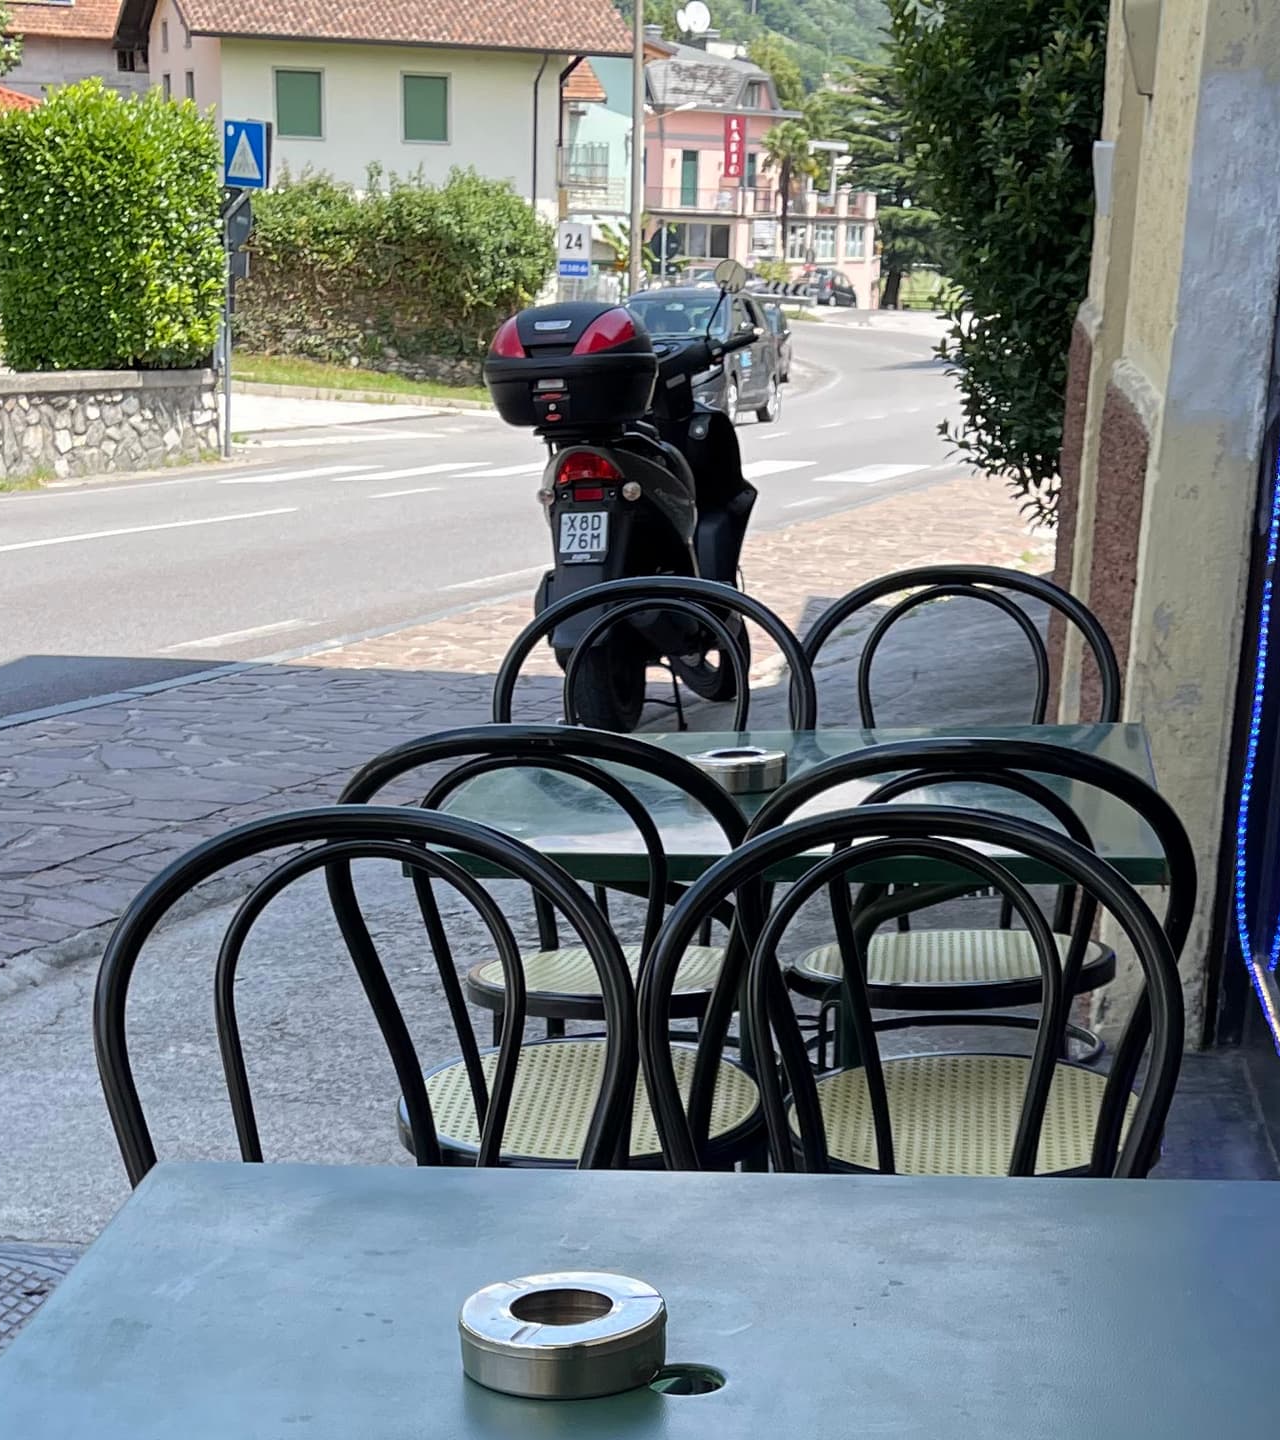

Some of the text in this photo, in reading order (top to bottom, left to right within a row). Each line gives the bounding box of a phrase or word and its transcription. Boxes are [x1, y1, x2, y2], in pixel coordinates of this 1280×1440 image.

[565, 233, 583, 250] 24
[567, 515, 601, 532] X8D
[566, 533, 601, 550] 76M
